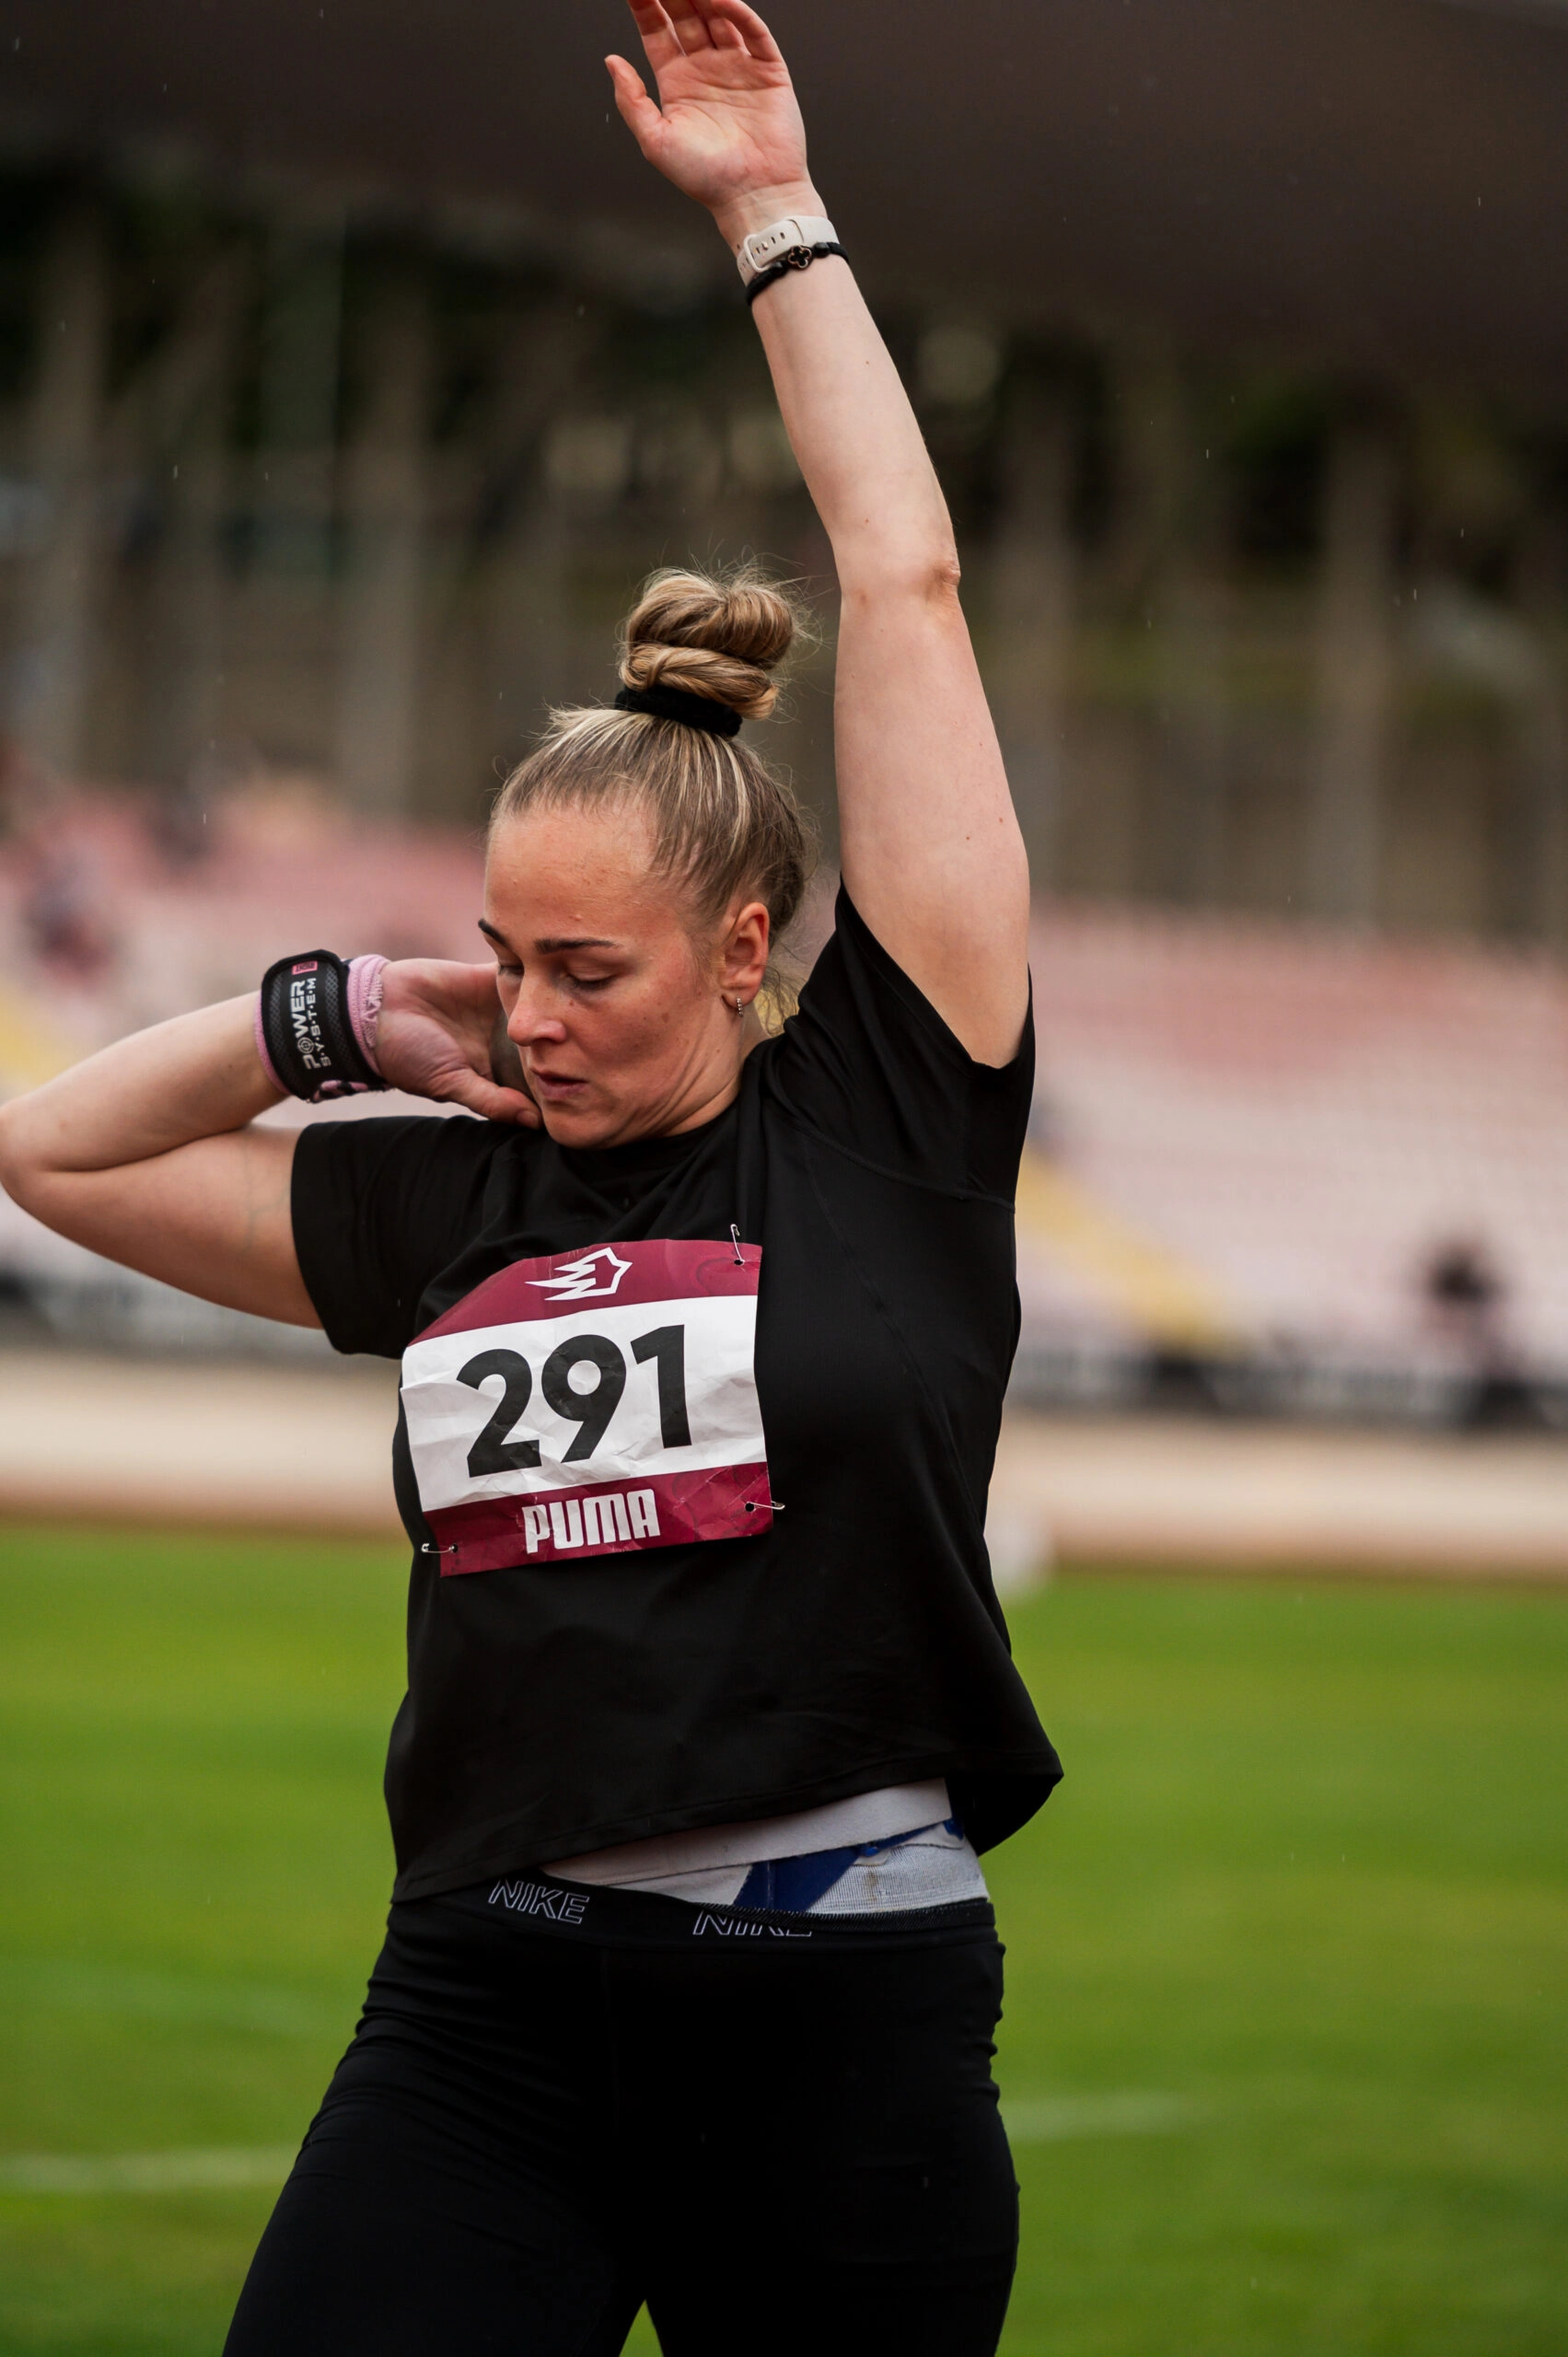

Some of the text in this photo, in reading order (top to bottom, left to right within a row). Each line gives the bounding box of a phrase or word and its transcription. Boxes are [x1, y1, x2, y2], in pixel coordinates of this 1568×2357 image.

[456, 1324, 692, 1478] 291
[522, 1489, 661, 1554] PUMA
[488, 1878, 590, 1924] NIKE
